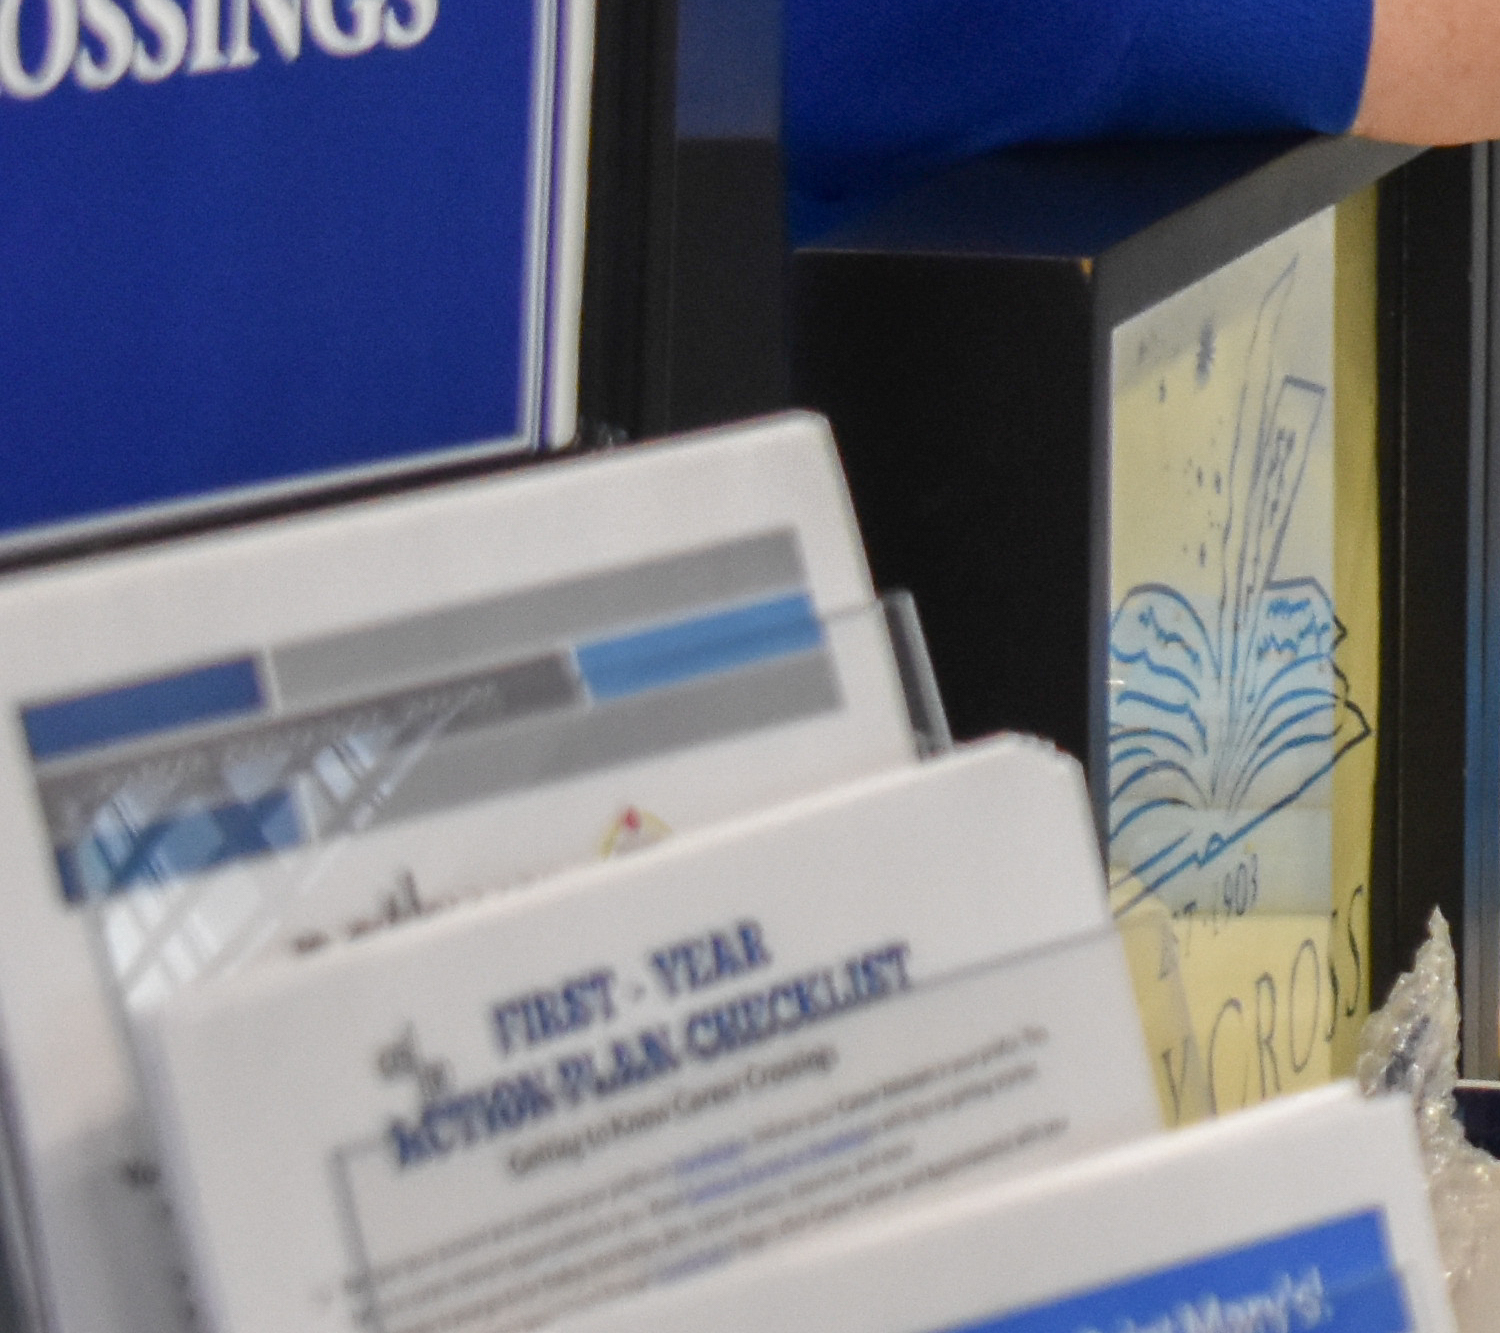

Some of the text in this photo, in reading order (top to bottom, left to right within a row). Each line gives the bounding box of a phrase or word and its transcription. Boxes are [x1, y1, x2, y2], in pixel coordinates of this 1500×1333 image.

[388, 1069, 555, 1171] ACTION
[556, 1025, 682, 1108] PLAN
[684, 940, 912, 1063] CHECKLIST
[489, 965, 616, 1057] FIRST
[647, 918, 774, 1000] YEAR
